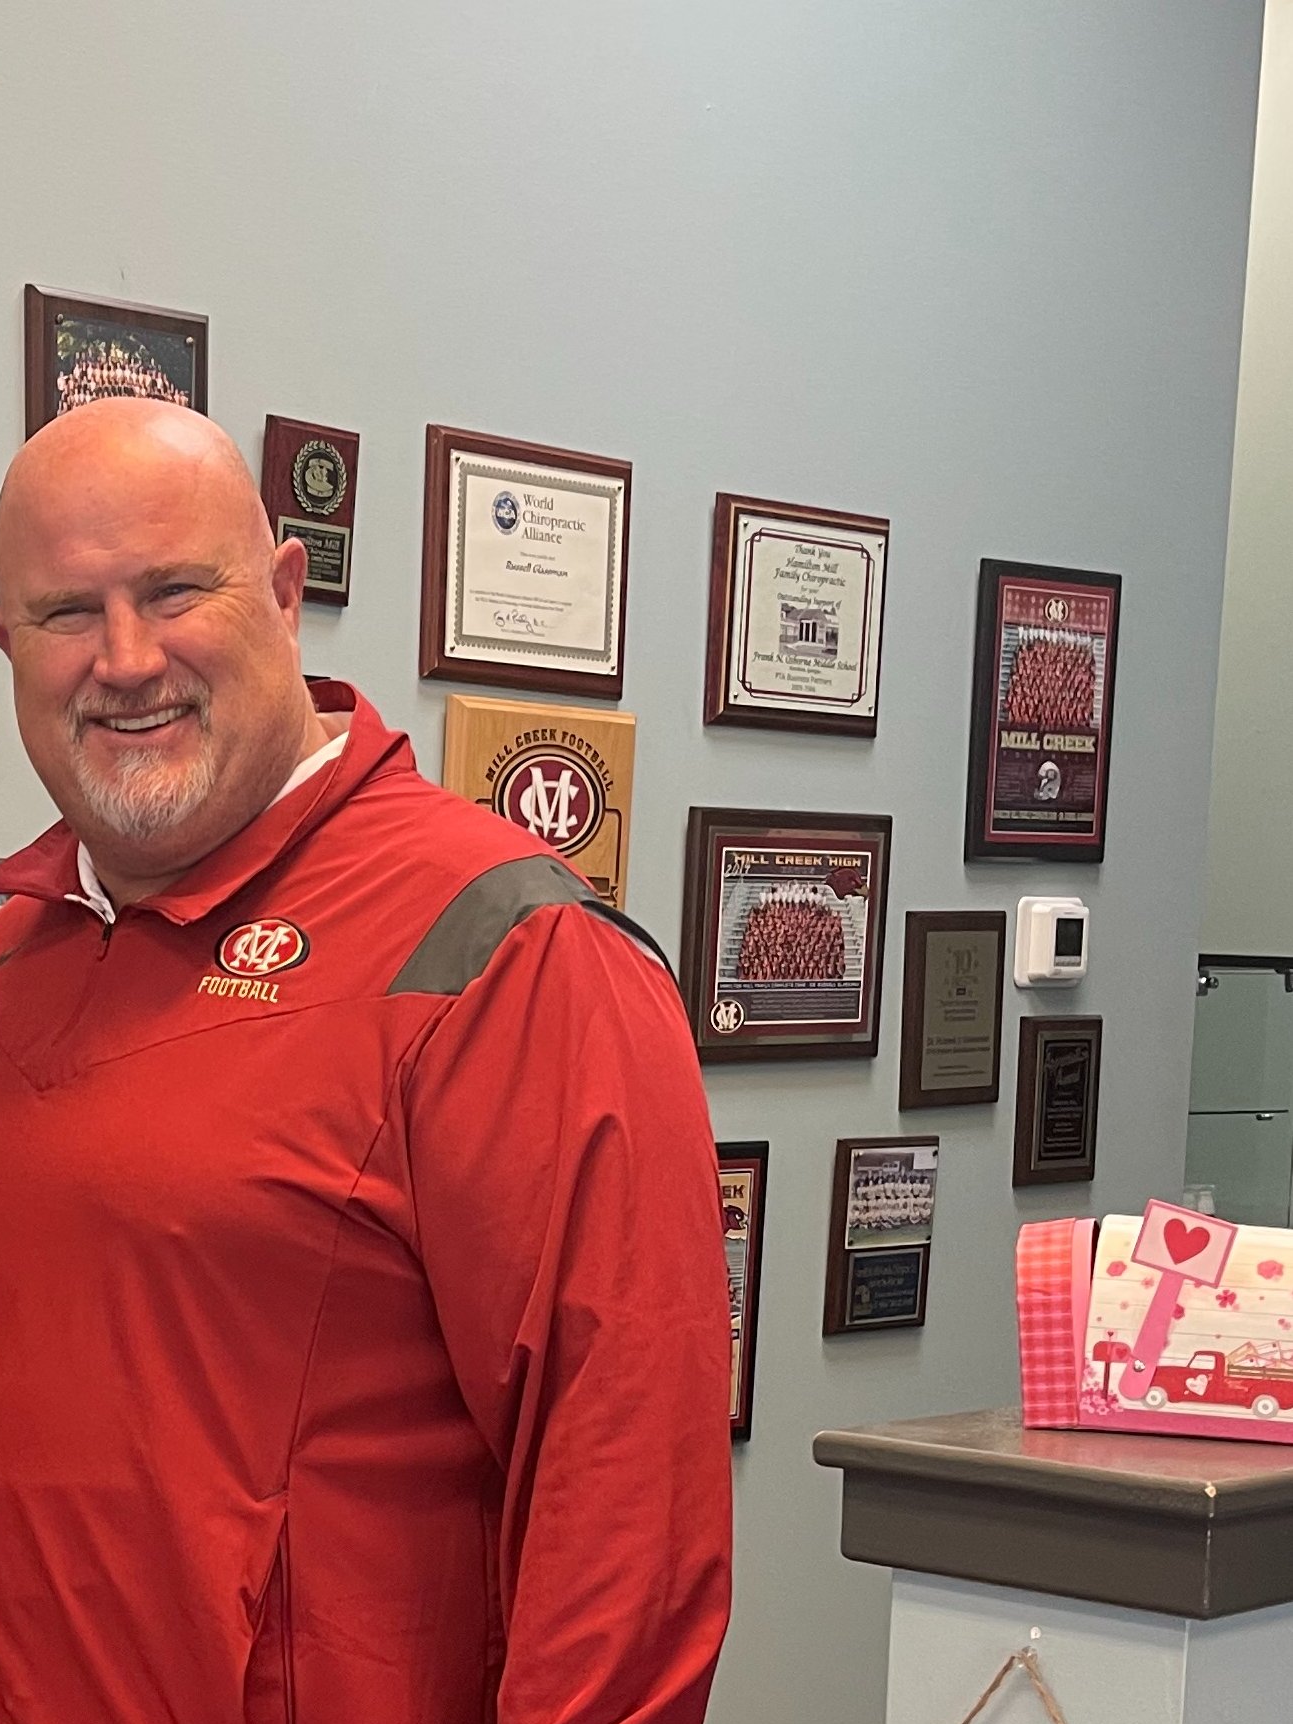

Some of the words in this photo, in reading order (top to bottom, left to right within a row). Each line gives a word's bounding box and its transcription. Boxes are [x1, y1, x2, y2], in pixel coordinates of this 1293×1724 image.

[523, 492, 554, 512] World
[522, 510, 586, 532] Chiropractic
[521, 526, 563, 545] Alliance
[794, 544, 816, 558] Thank
[785, 556, 821, 573] Hamilton
[772, 567, 801, 584] Family
[801, 571, 846, 588] Chiropractic
[1000, 729, 1041, 751] MILL
[1042, 733, 1096, 753] CREEK
[485, 744, 513, 782] MILL
[515, 728, 558, 749] CREEK
[561, 730, 614, 792] FOOTBALL
[732, 853, 769, 866] MILL
[775, 854, 823, 867] CREEK
[828, 856, 862, 868] HIGH
[197, 975, 280, 1004] FOOTBALL
